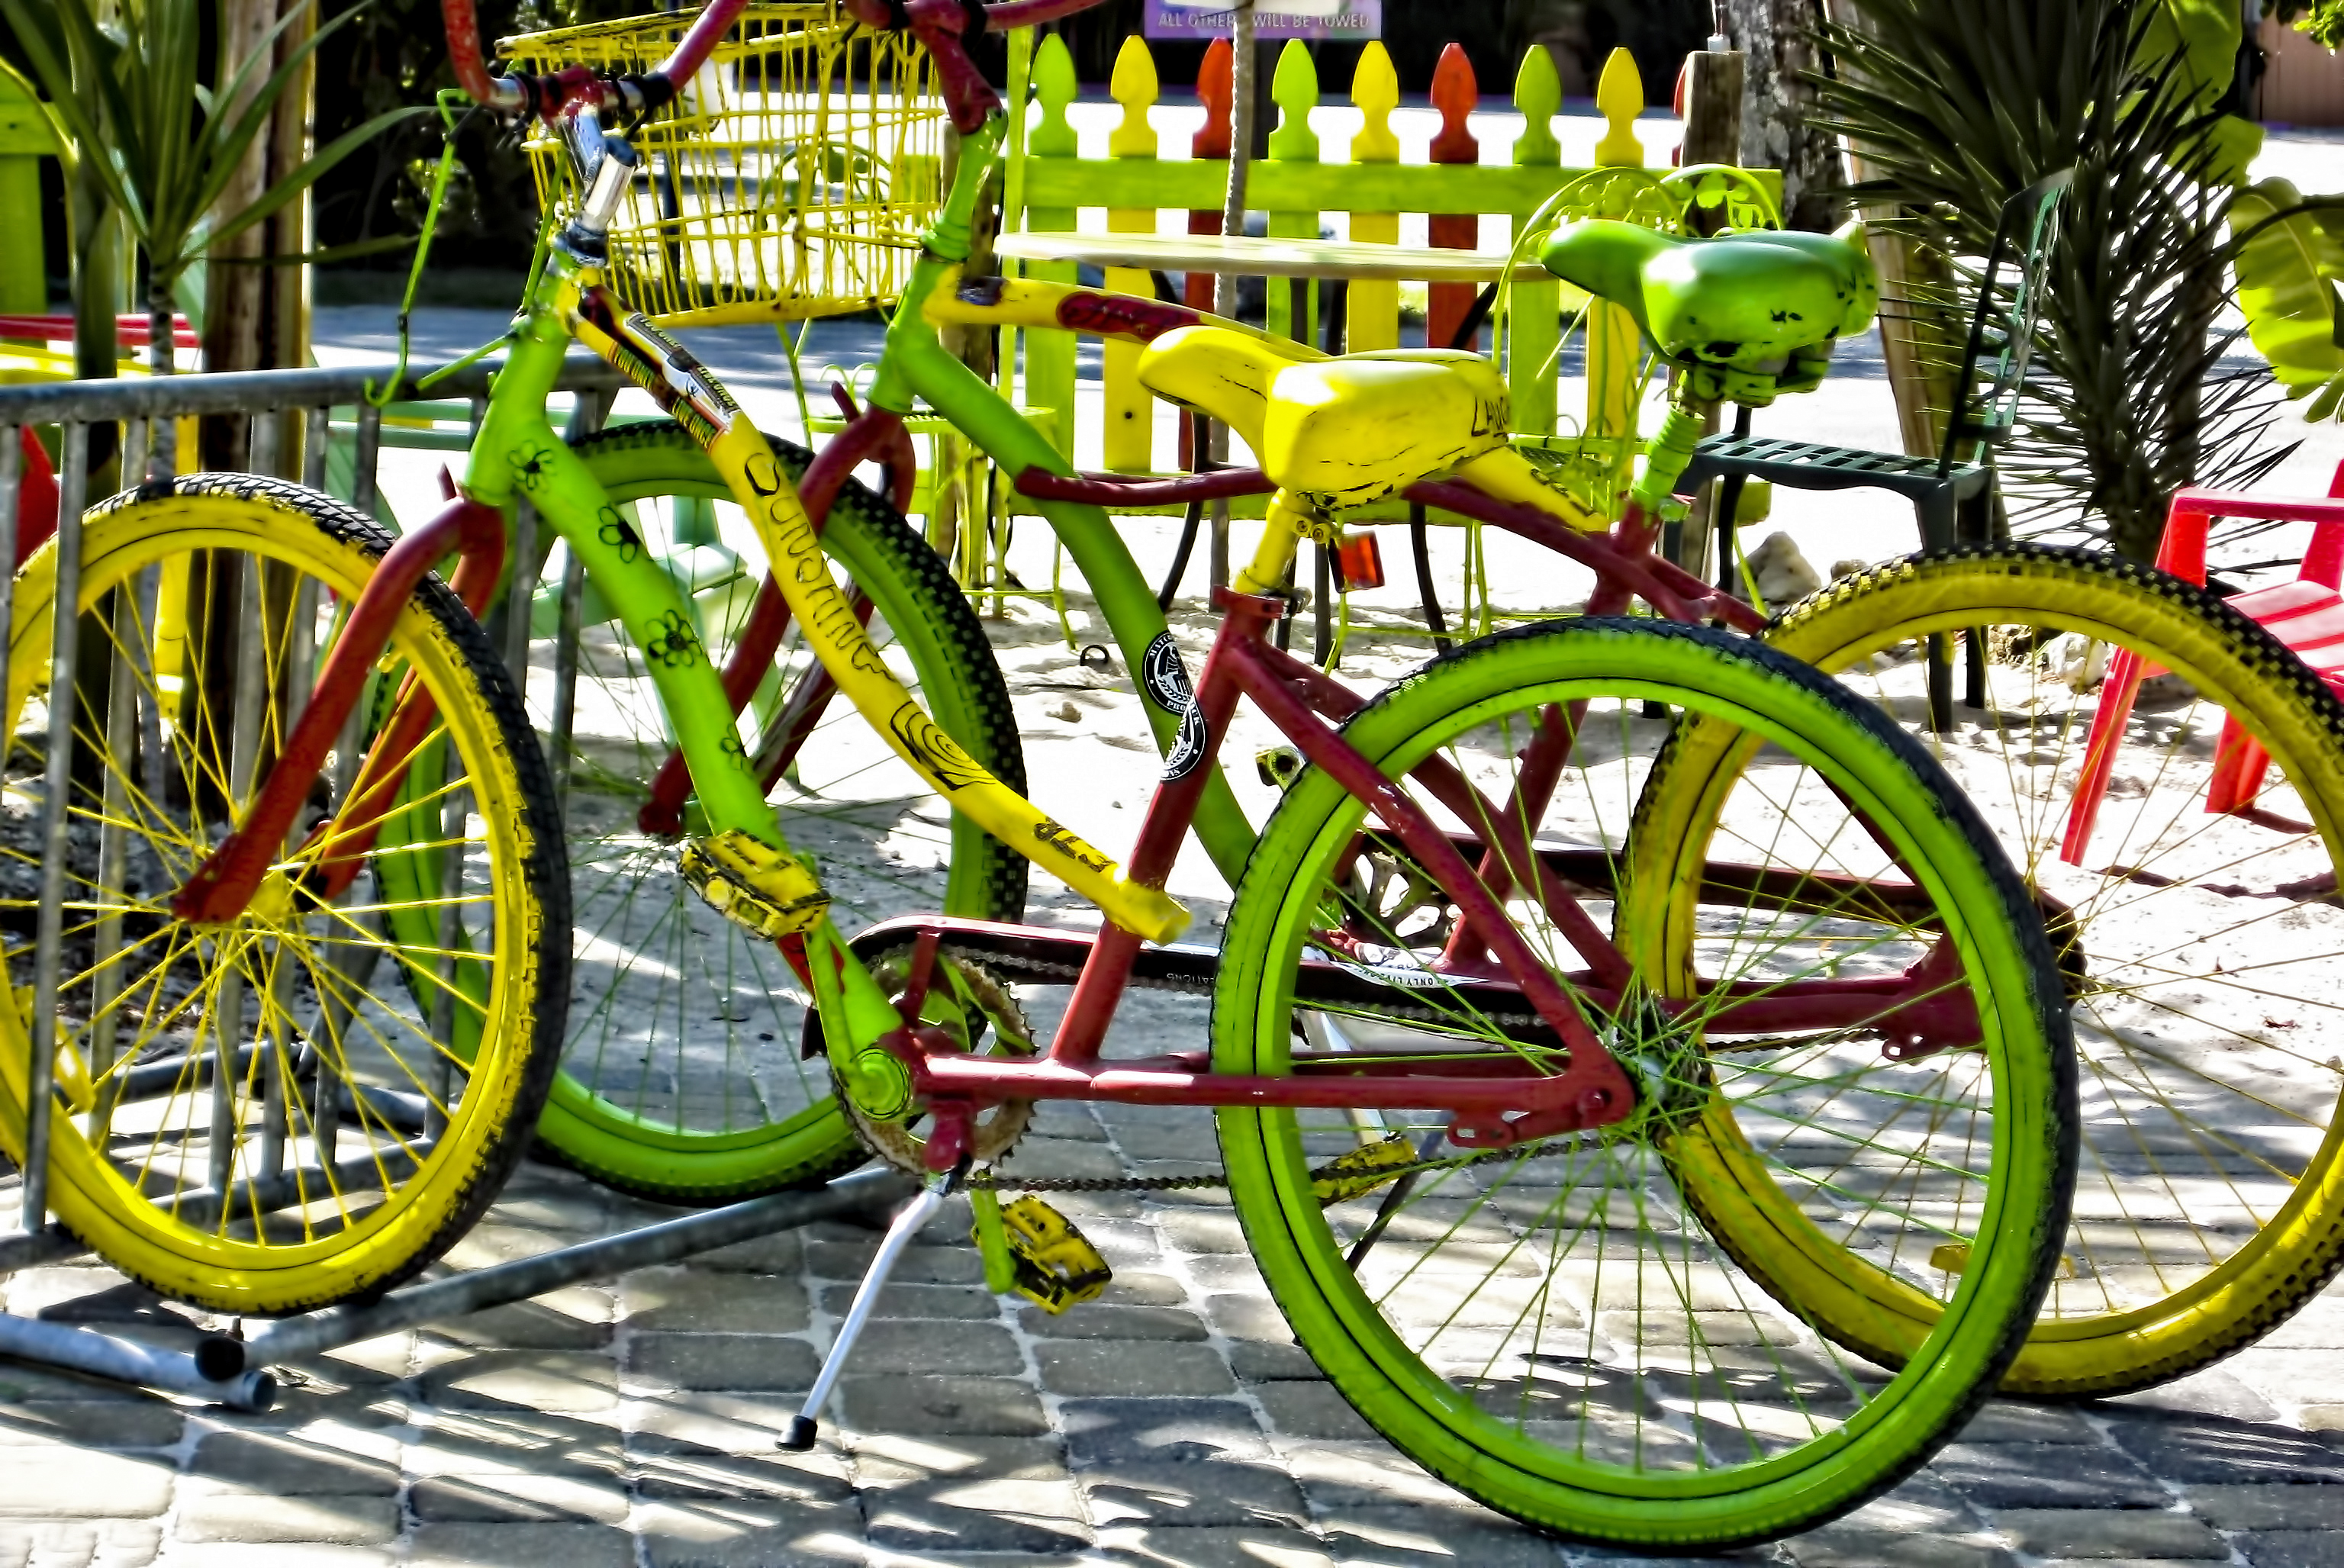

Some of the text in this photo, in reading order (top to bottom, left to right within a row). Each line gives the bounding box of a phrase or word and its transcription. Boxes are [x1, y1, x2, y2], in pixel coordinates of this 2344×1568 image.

[1158, 12, 1183, 27] ALL
[1253, 12, 1286, 27] WILL
[1293, 13, 1310, 27] BE
[1318, 13, 1370, 28] TOWED
[1406, 977, 1434, 987] ONLY
